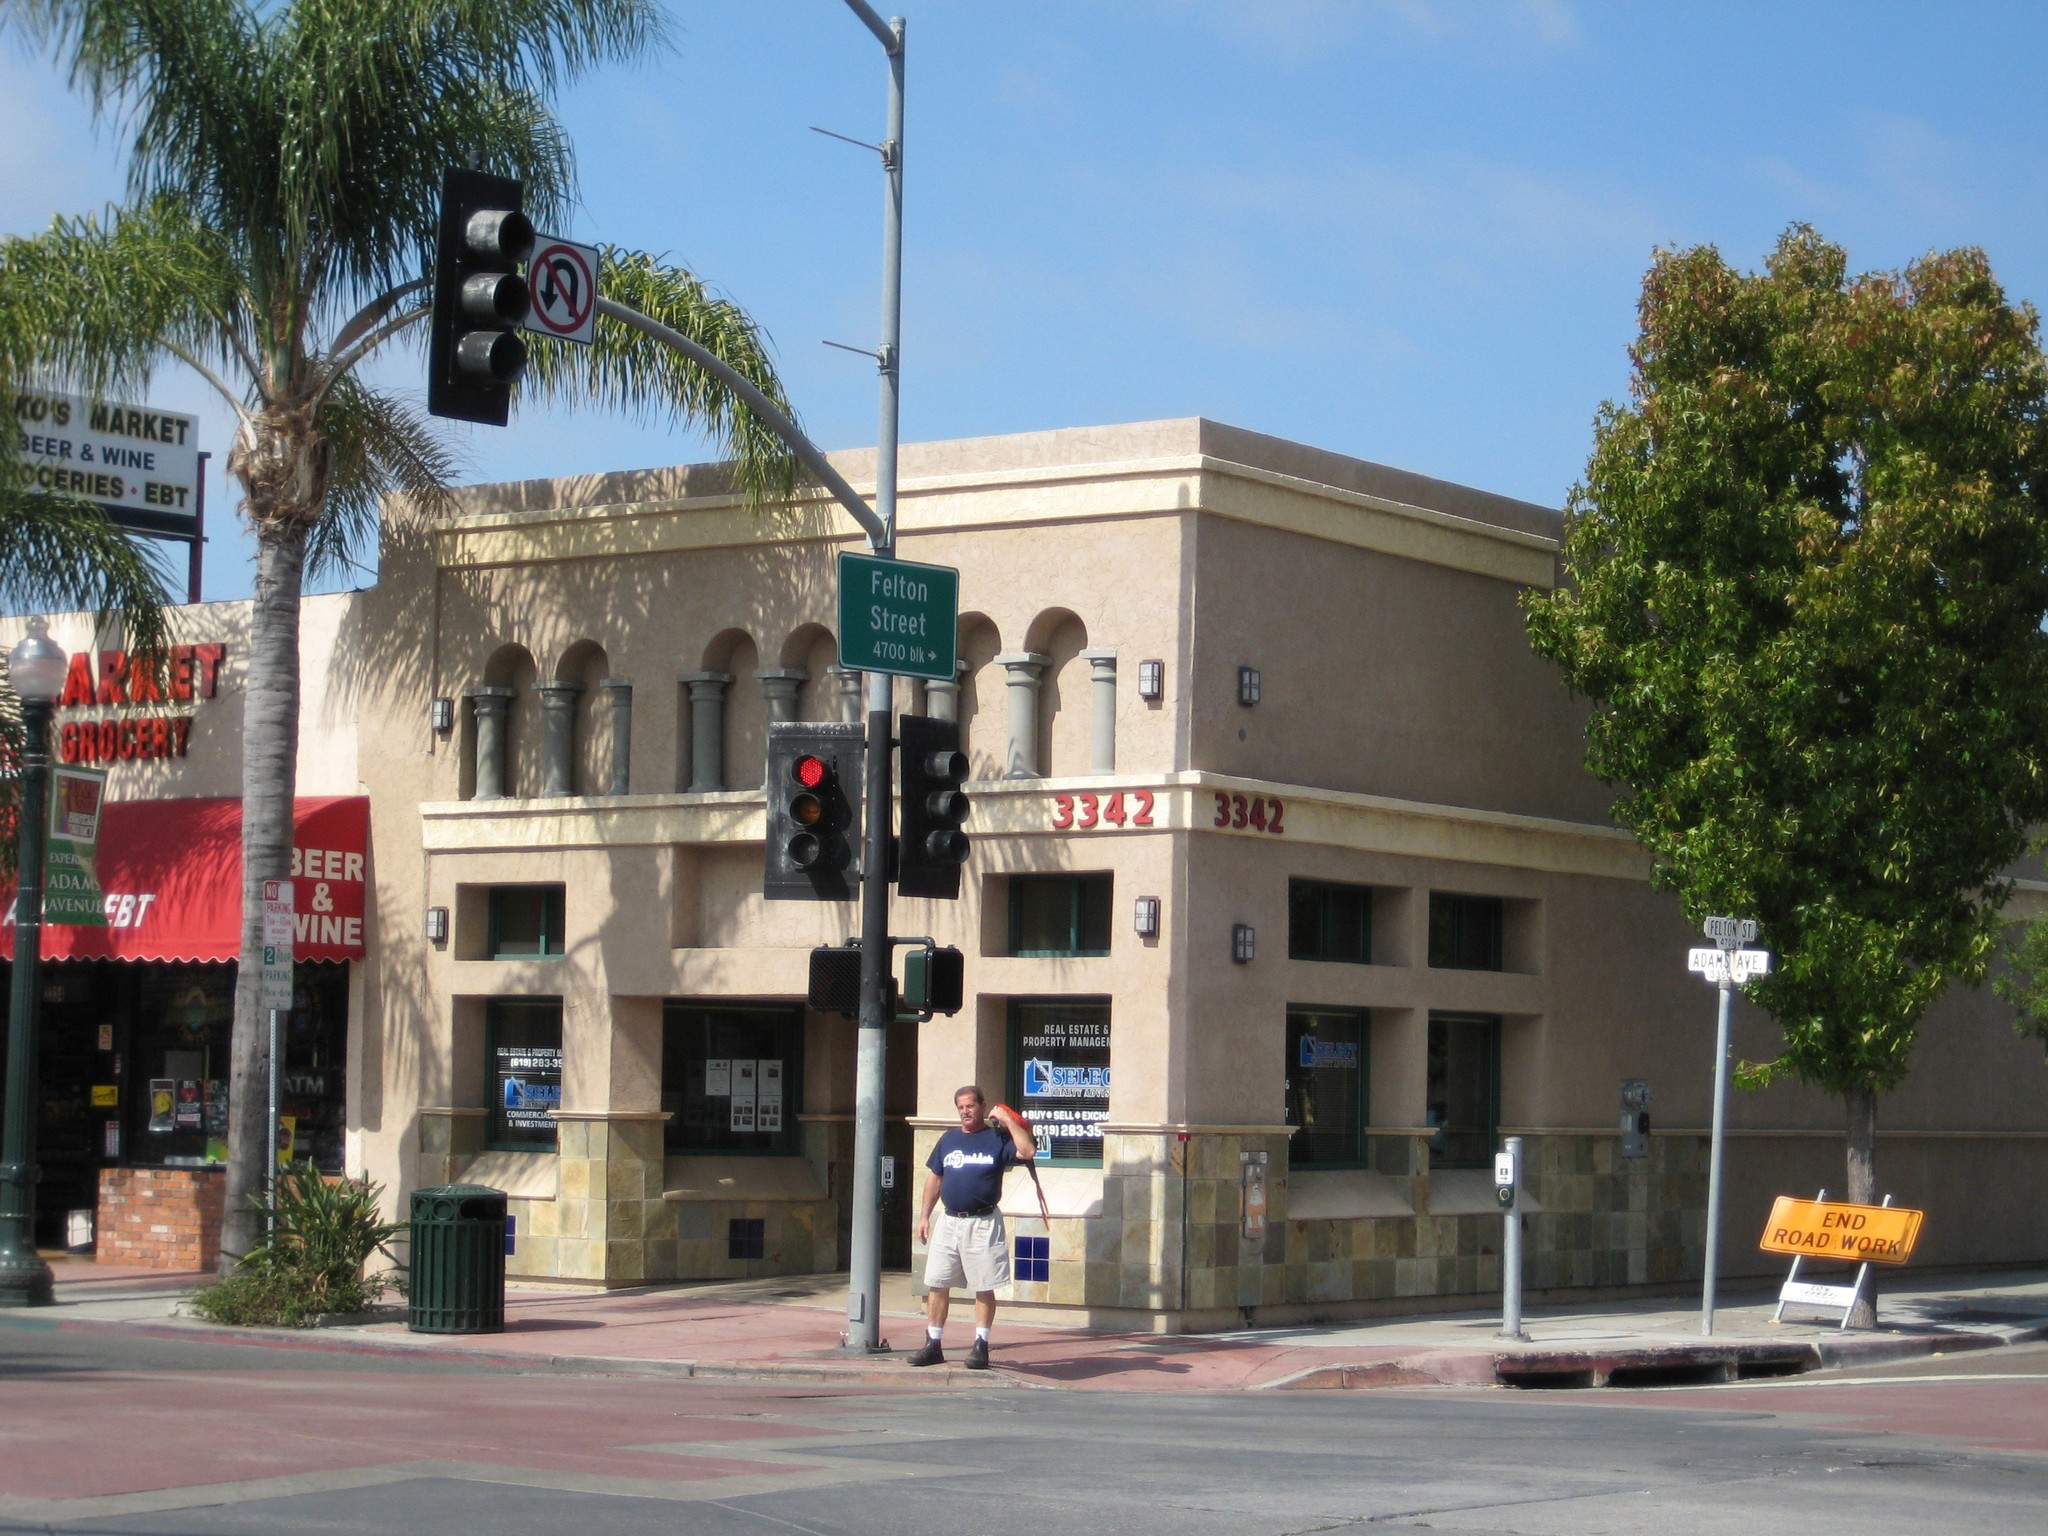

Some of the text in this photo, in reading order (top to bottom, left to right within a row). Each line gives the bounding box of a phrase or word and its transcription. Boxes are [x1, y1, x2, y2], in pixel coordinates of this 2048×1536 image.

[91, 405, 189, 446] MARKET
[19, 432, 155, 471] BEER & WINE
[145, 481, 188, 508] EBT
[872, 570, 928, 602] Felton
[870, 605, 926, 636] Street
[873, 641, 925, 663] 4700 blk
[53, 643, 225, 706] ARKET
[61, 717, 192, 764] GROCERY
[1053, 789, 1154, 829] 3342
[1214, 792, 1285, 834] 3342
[290, 847, 364, 882] BEER
[266, 884, 277, 899] NO
[312, 882, 334, 912] &
[49, 897, 105, 914] AVENUE
[105, 894, 156, 928] EBT
[266, 902, 291, 914] PARKING
[292, 912, 363, 946] WINE
[1710, 920, 1736, 937] FELTON
[266, 948, 275, 962] 2
[1692, 952, 1762, 971] ADAMS AVE.
[265, 969, 292, 981] PARKING
[1044, 1024, 1109, 1035] REAL ESTATE &
[1023, 1036, 1066, 1047] PROPERTY
[497, 1047, 509, 1056] REAL
[510, 1047, 527, 1057] ESTATE
[532, 1048, 556, 1058] PROPERTY
[510, 1057, 532, 1068] (619)
[284, 1075, 325, 1094] ATM
[1052, 1066, 1111, 1087] SELEC
[508, 1119, 514, 1128] &
[1028, 1110, 1047, 1120] BUY
[1053, 1110, 1074, 1121] SELL
[1032, 1124, 1059, 1137] (619)
[1822, 1211, 1867, 1230] END
[1772, 1228, 1902, 1256] ROAD WORK
